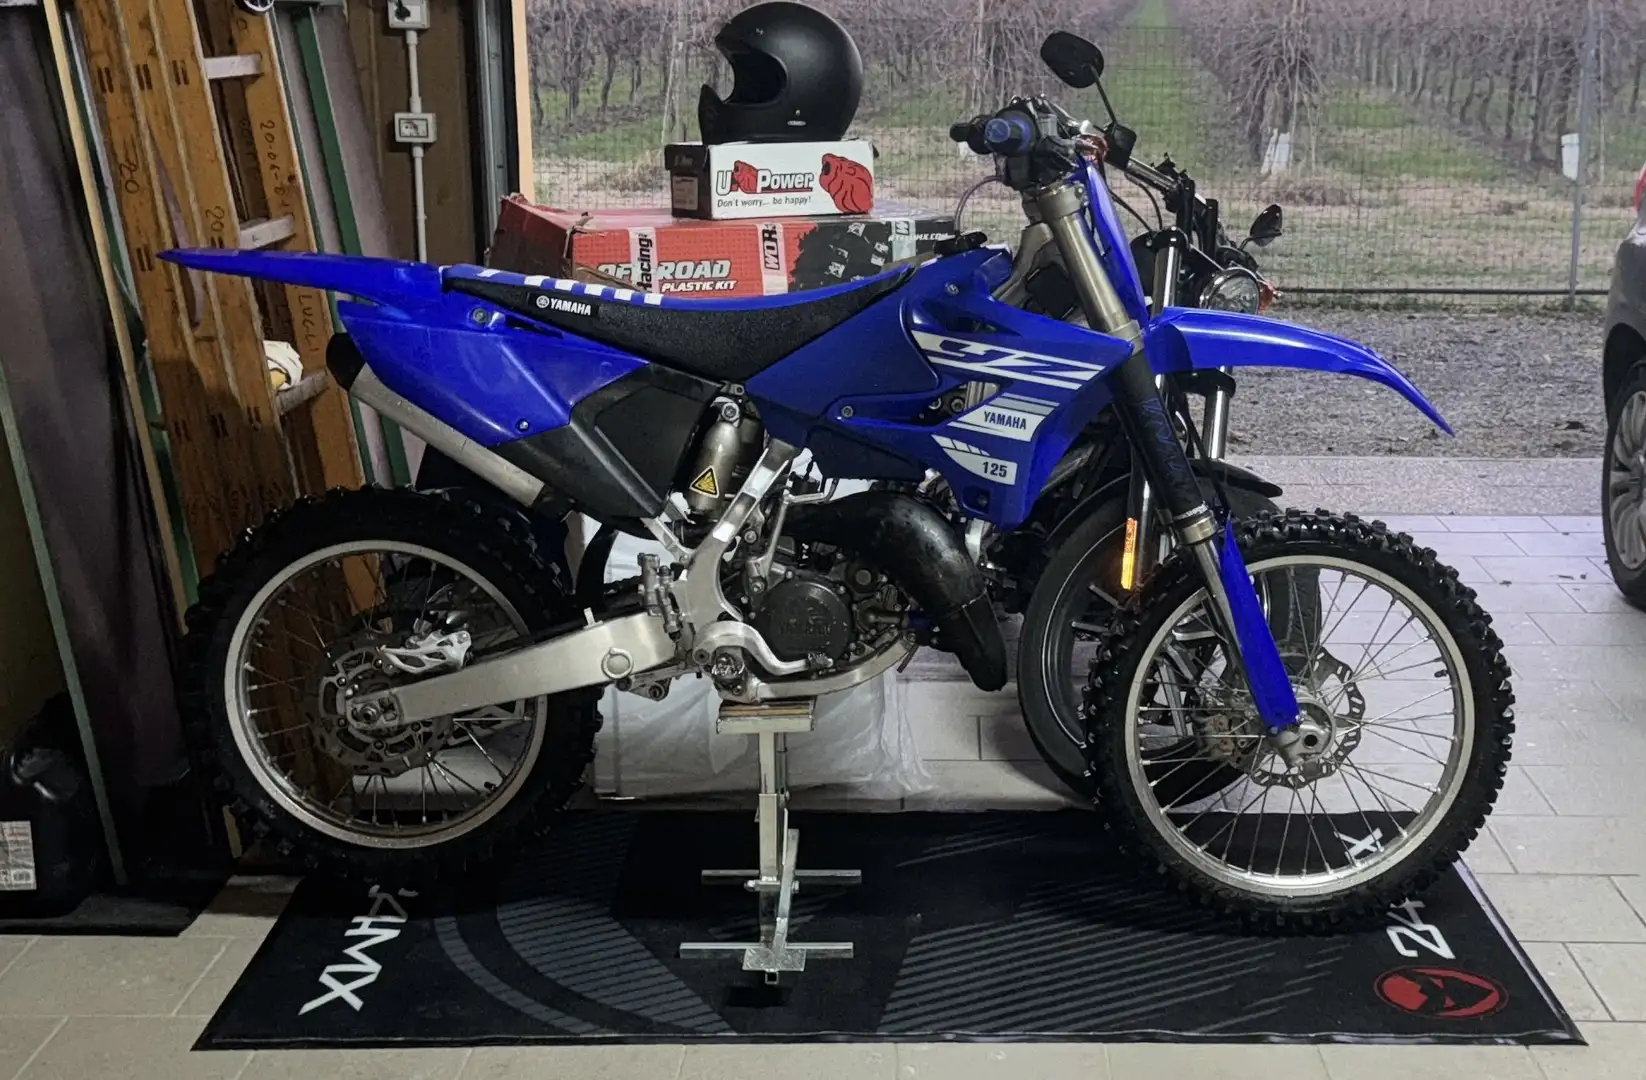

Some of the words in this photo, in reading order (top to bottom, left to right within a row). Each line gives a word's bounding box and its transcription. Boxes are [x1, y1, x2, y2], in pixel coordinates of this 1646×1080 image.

[715, 170, 732, 196] U
[757, 169, 815, 194] Power
[717, 199, 740, 208] Don't
[772, 196, 783, 205] be
[784, 195, 812, 207] happy!
[661, 281, 714, 293] PLASTIC
[714, 280, 737, 291] KIT
[550, 297, 592, 316] YAMAHA
[983, 411, 1027, 430] YAMAHA
[982, 461, 1008, 478] 125
